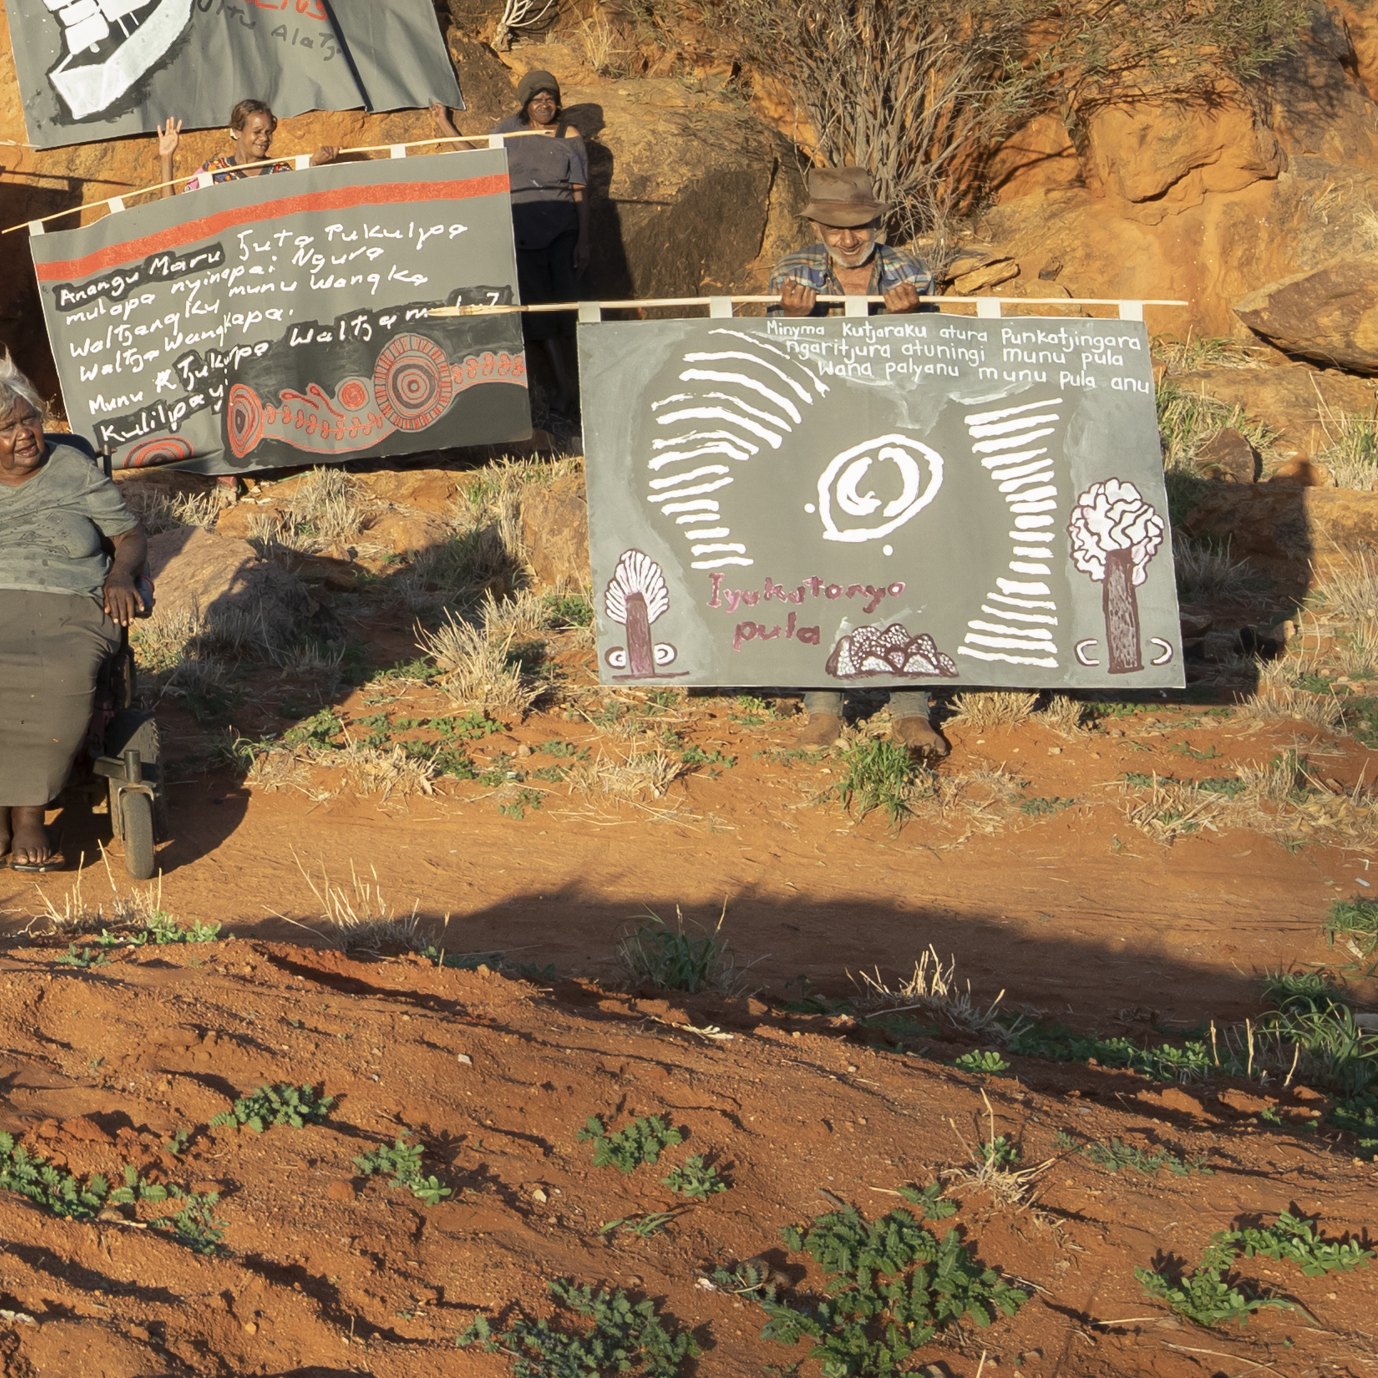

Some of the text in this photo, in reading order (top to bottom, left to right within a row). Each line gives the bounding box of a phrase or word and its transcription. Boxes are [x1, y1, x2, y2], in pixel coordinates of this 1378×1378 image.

[60, 273, 139, 306] Anangu
[149, 251, 220, 275] Maru
[66, 294, 155, 325] mulapa
[292, 246, 384, 272] Ngura
[228, 281, 296, 297] munu
[767, 320, 1141, 353] Minyma Kutjaraku atura Punkatjingara
[902, 340, 985, 368] atuningi
[1003, 347, 1066, 364] munu
[1082, 350, 1123, 370] pula
[885, 358, 959, 383] palyanu
[979, 367, 1047, 382] munu
[1060, 370, 1095, 390] pula
[1111, 377, 1149, 394] anu
[88, 392, 143, 415] Munu
[733, 612, 820, 652] pula
